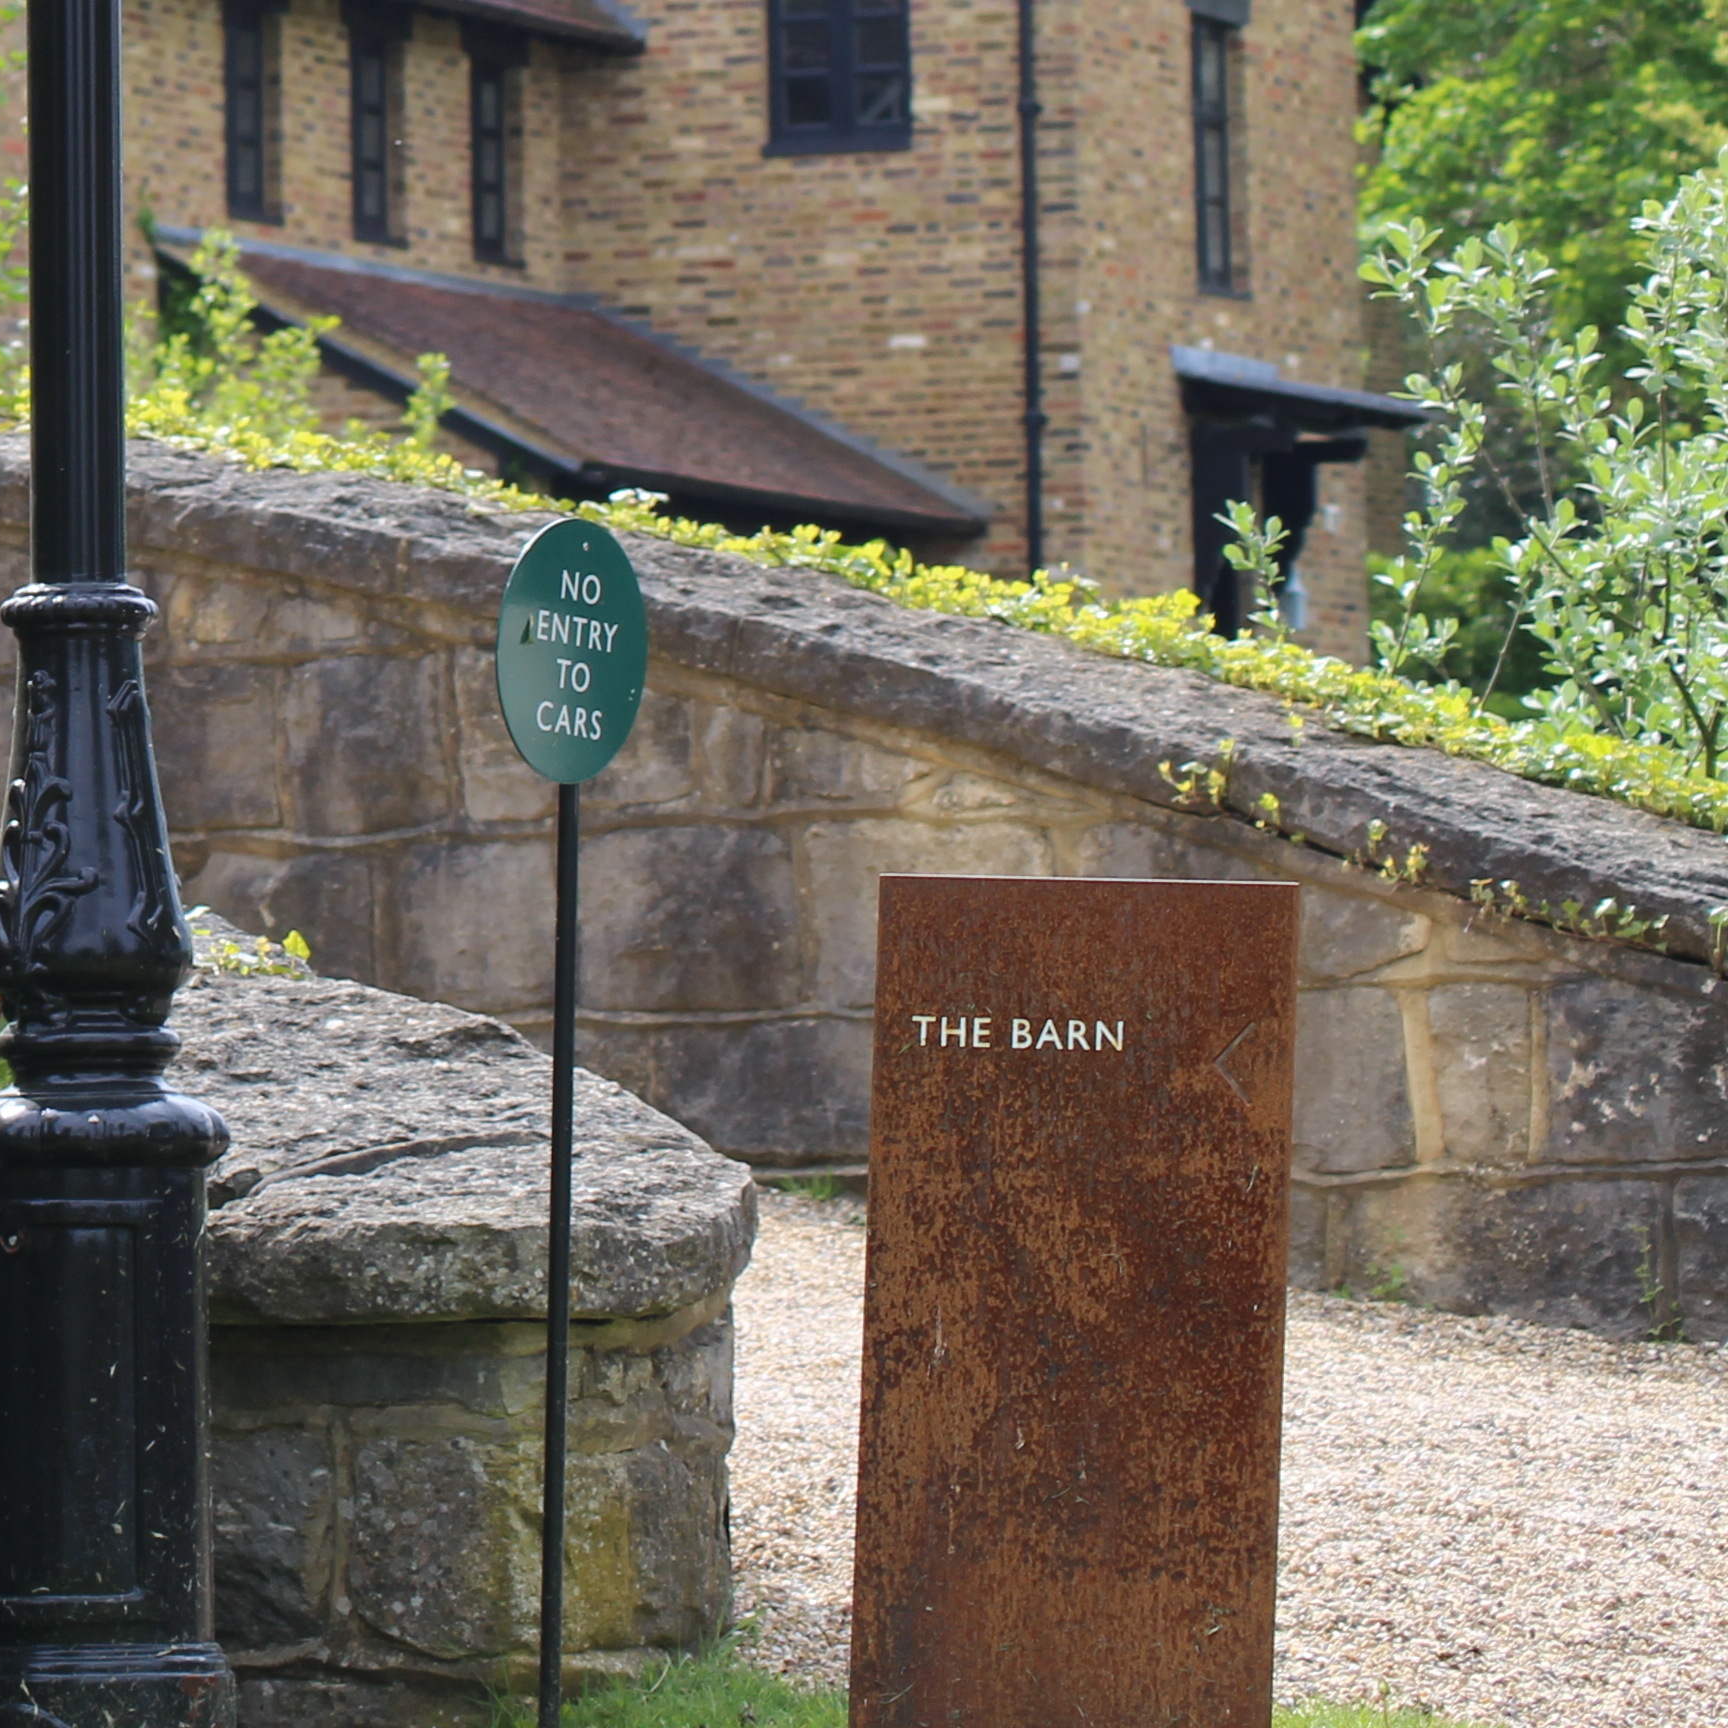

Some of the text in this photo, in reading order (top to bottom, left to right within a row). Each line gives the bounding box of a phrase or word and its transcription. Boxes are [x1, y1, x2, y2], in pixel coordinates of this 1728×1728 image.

[560, 569, 602, 605] NO
[536, 609, 619, 653] ENTRY
[556, 658, 591, 693] TO
[536, 700, 603, 741] CARS
[911, 1015, 1125, 1051] THE BARN
